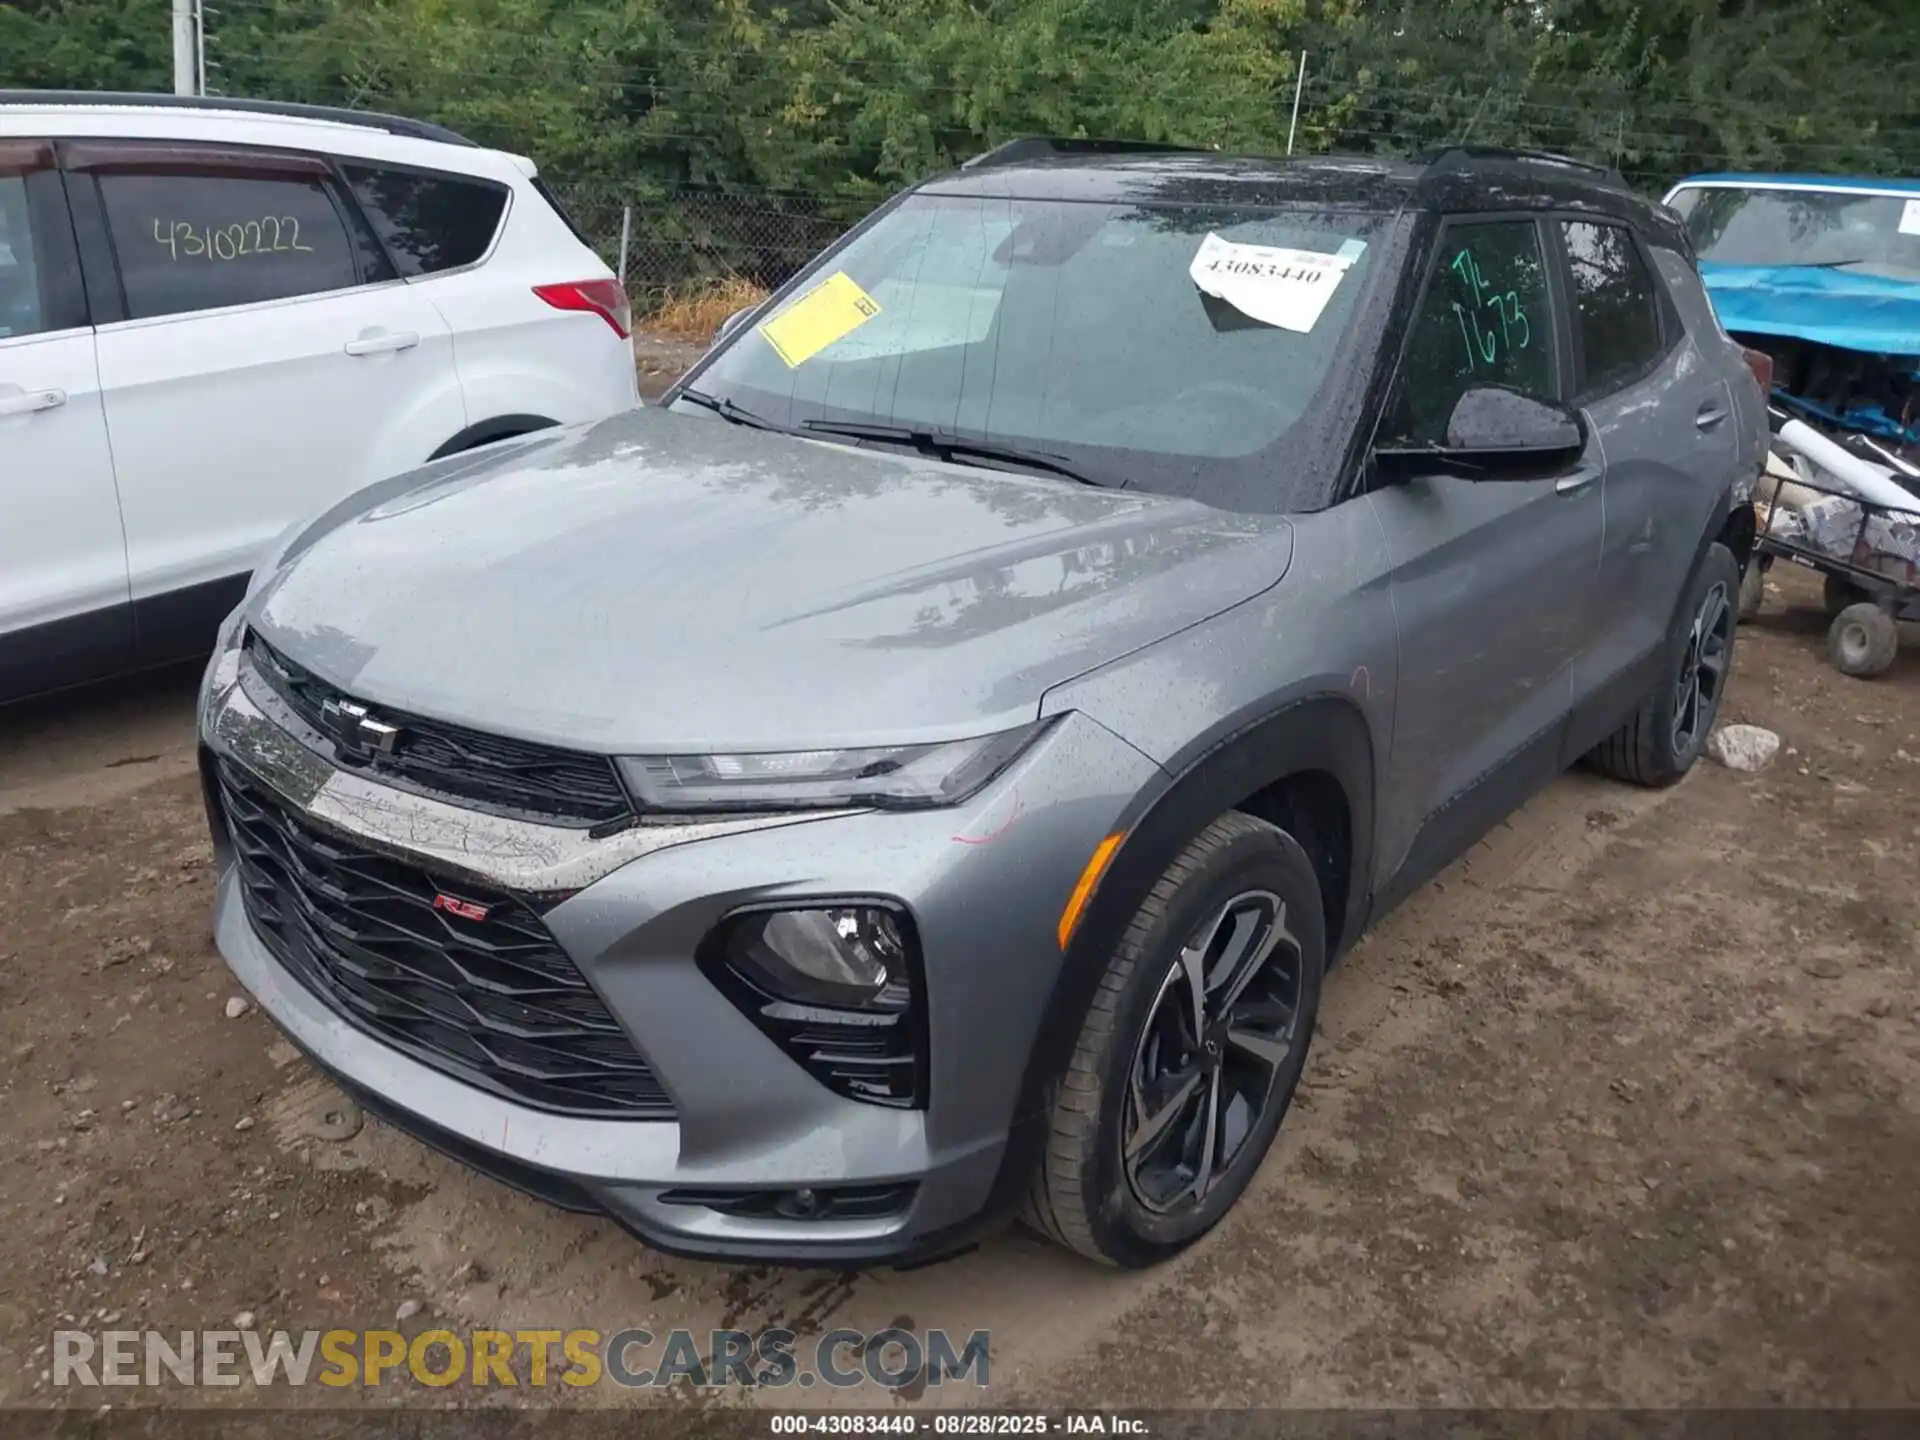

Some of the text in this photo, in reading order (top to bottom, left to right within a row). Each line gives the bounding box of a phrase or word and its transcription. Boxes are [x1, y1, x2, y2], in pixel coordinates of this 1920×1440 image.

[153, 215, 314, 261] 43102222
[1206, 259, 1322, 284] 43083440
[433, 894, 488, 921] RS
